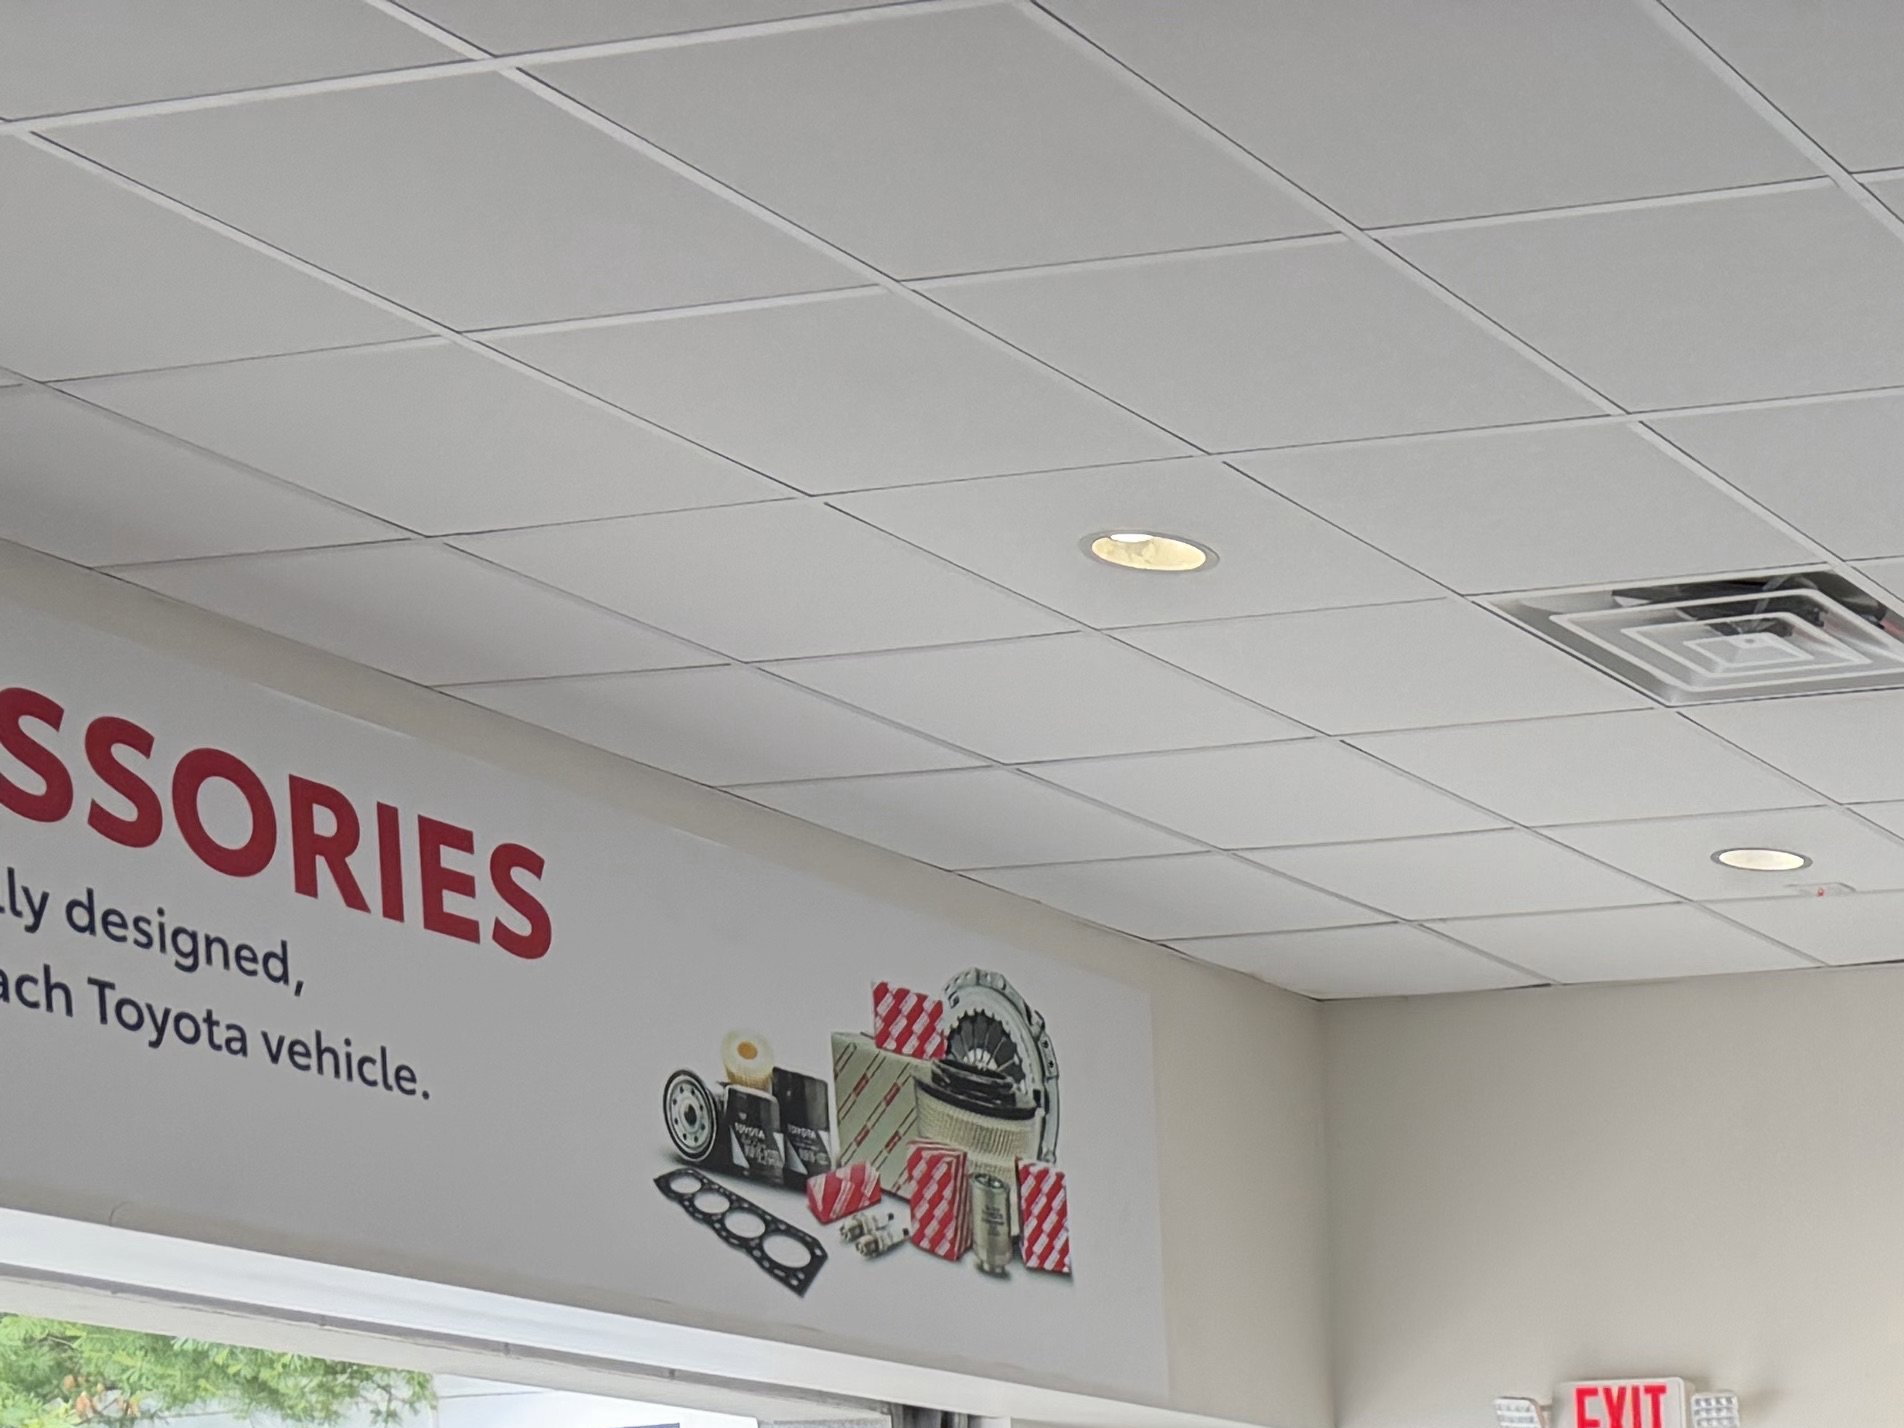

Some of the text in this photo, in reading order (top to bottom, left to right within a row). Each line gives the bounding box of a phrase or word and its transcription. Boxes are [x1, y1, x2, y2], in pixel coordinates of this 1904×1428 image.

[0, 686, 553, 960] SSORIES
[0, 866, 306, 997] ly designed,
[87, 976, 248, 1058] Toyota
[261, 1027, 431, 1100] vehicle.
